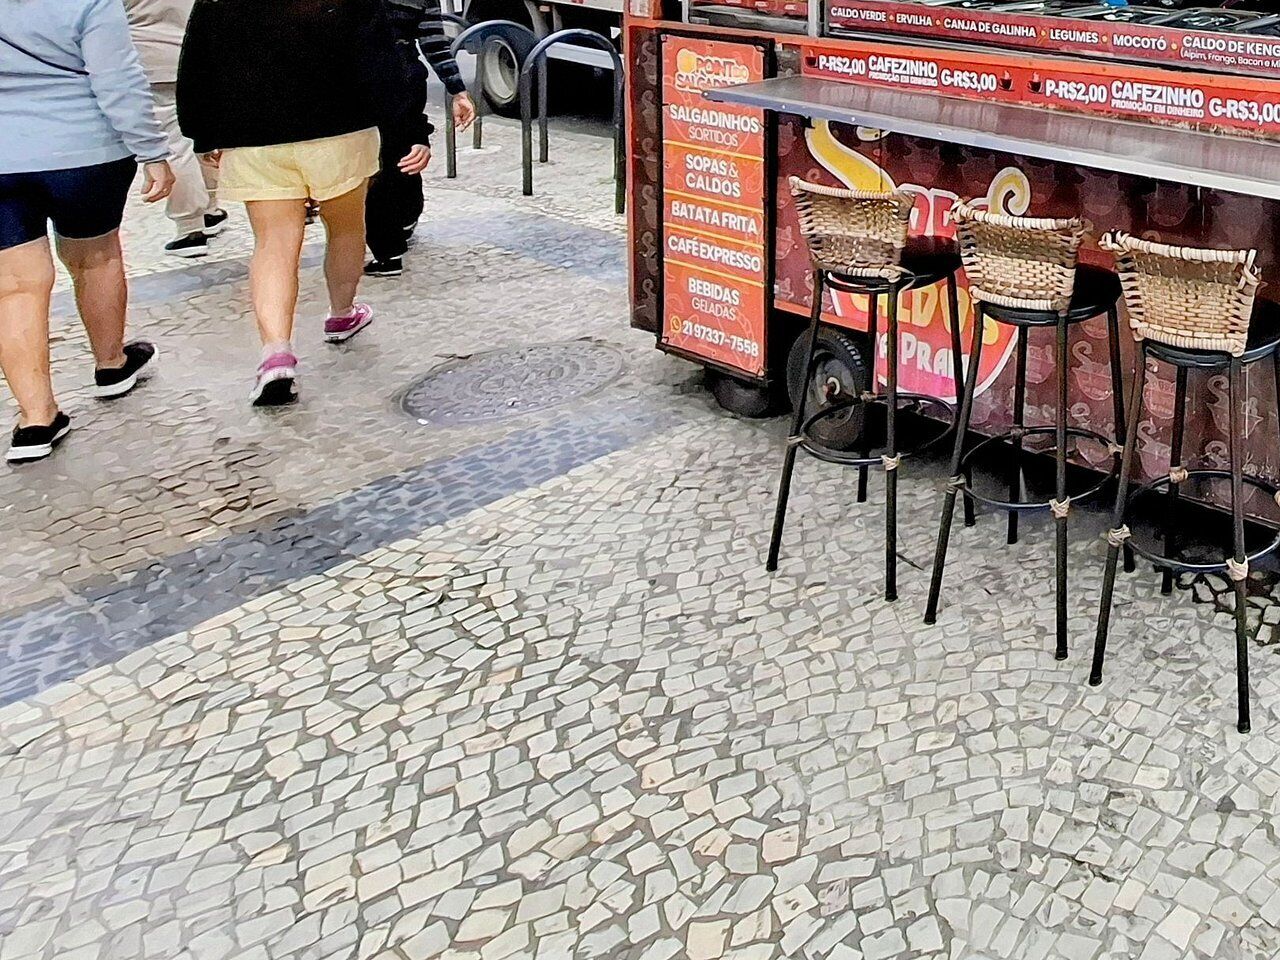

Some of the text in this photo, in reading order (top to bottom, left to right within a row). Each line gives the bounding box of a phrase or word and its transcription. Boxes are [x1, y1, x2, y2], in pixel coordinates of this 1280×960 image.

[831, 7, 887, 21] CALDO VERDE
[896, 13, 933, 26] ERVILHA
[944, 18, 1036, 37] CANJA DE GALINHA
[1050, 29, 1099, 43] LEGUMES
[1113, 34, 1167, 51] MOCOTÓ
[1183, 35, 1226, 51] CALDO
[1228, 40, 1244, 54] DE
[868, 55, 937, 78] CAFEZINHO
[1238, 56, 1263, 66] Bacon
[1111, 80, 1204, 108] CAFEZINHO
[669, 104, 759, 133] SALGADINHOS
[1111, 99, 1204, 118] PROMOÇÃO EM DINHEIRO
[688, 126, 738, 147] SORTIDOS
[686, 153, 738, 178] SOPAS &
[686, 172, 741, 198] CALDOS
[671, 200, 757, 235] BATATA FRITA
[668, 235, 760, 272] CAFÉ EXPRESSO
[688, 277, 739, 305] BEBIDAS
[692, 297, 736, 321] GELADAS
[683, 320, 758, 357] 21 97337-7558
